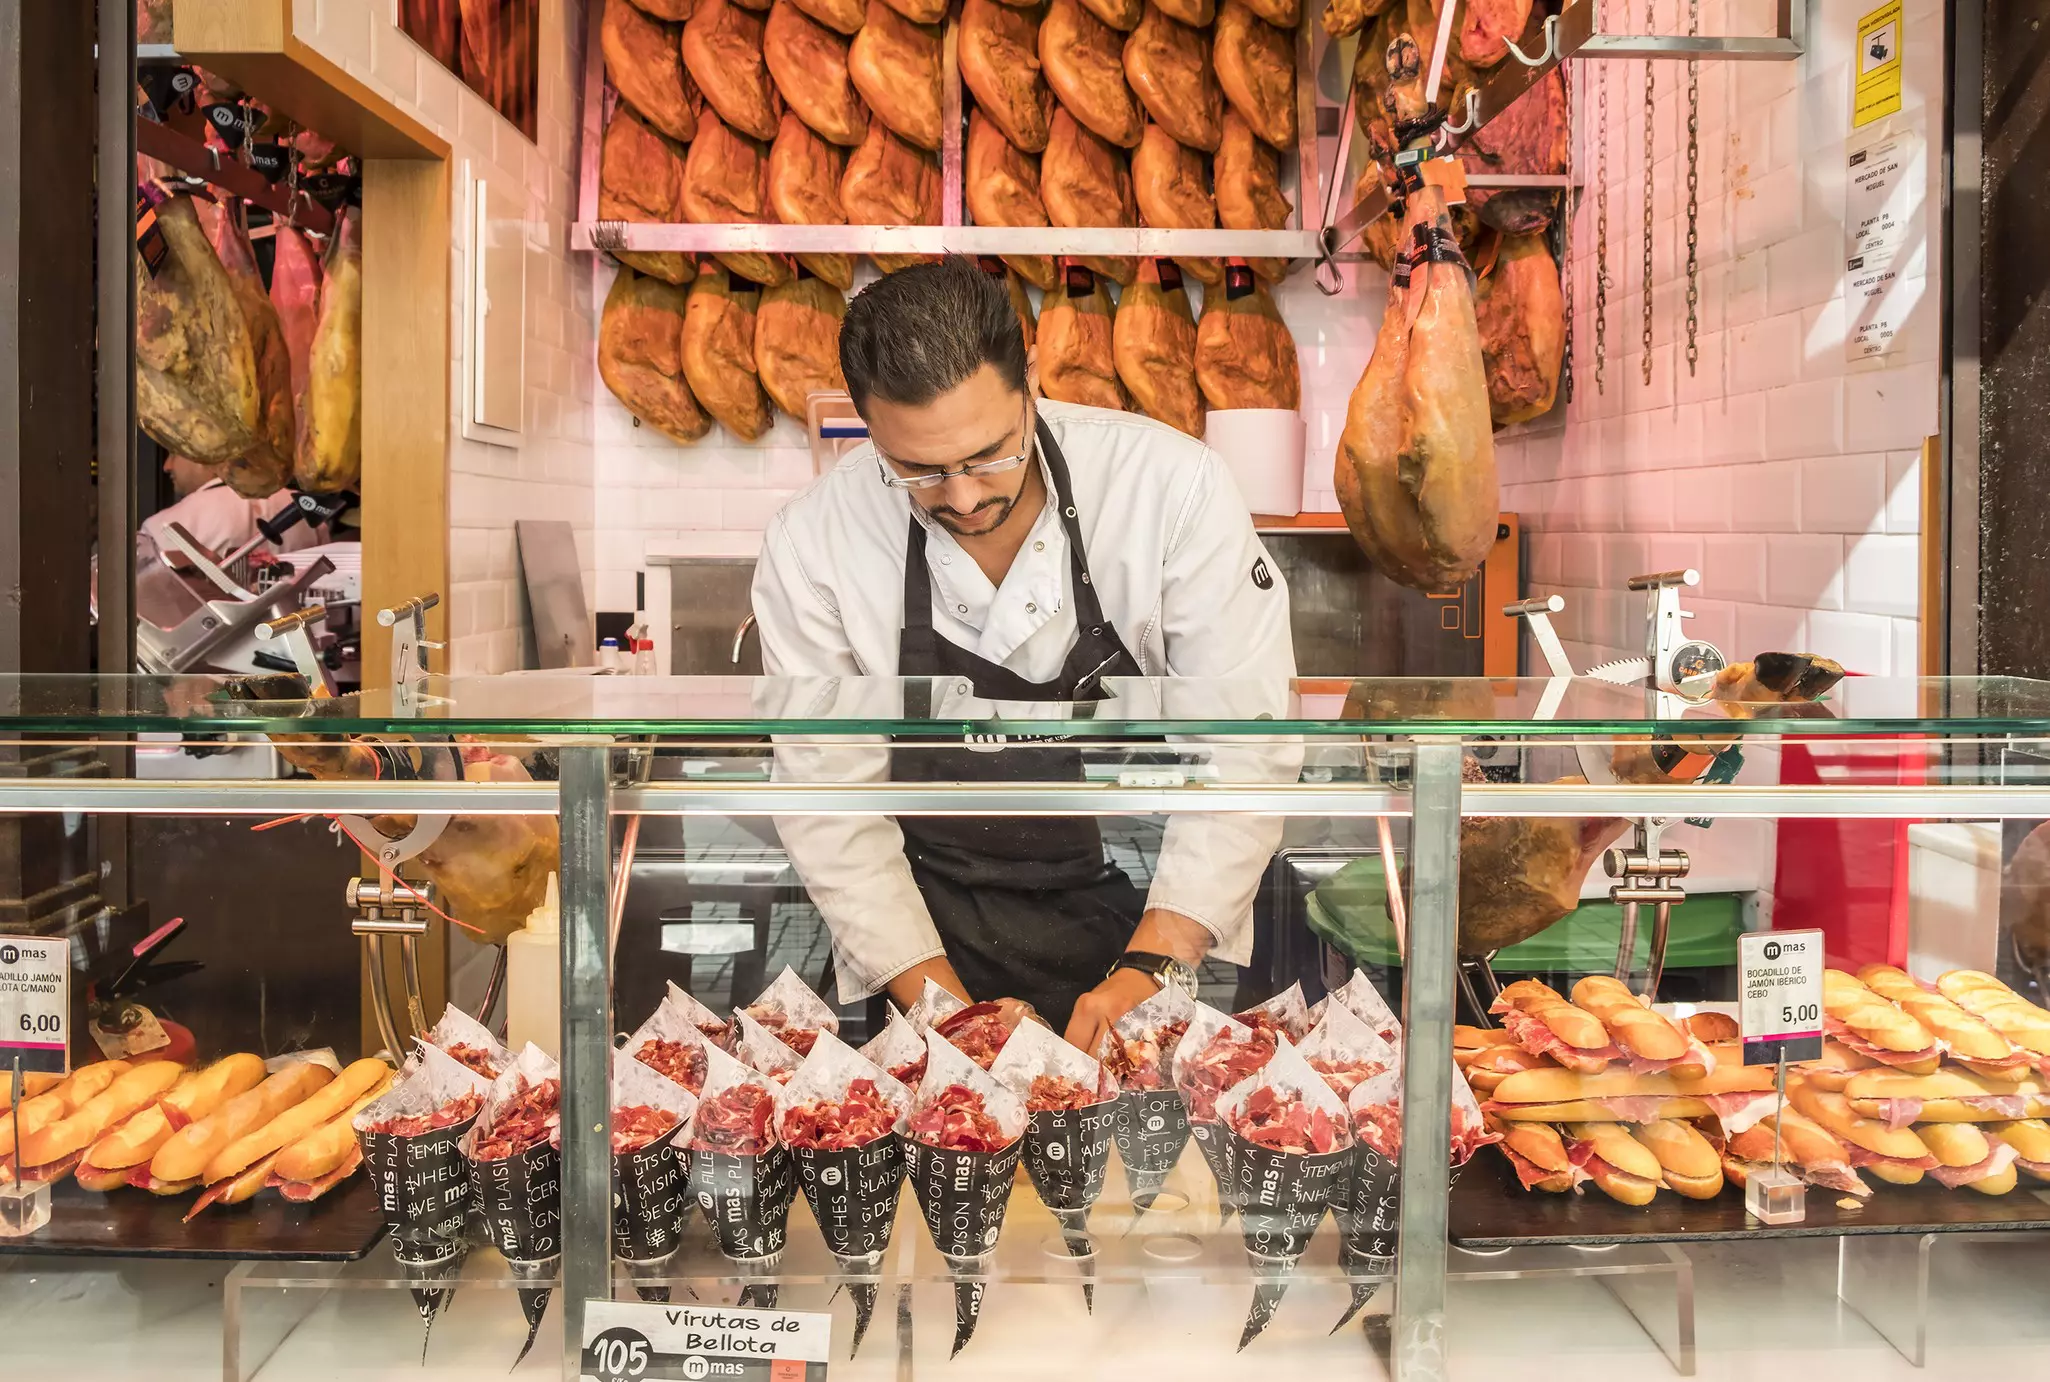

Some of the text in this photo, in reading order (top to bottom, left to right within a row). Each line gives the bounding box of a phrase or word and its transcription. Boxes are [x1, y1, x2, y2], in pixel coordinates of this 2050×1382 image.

[1855, 170, 1878, 184] MERCADO
[1879, 167, 1886, 175] DE
[1887, 162, 1898, 172] SAN
[1856, 221, 1895, 239] LOCAL 0004
[1861, 216, 1880, 228] PLANTA
[1865, 240, 1883, 250] CENTRO
[1853, 277, 1875, 288] MERCADO
[1884, 272, 1895, 280] SAN
[1860, 323, 1878, 332] PLANTA
[1854, 331, 1893, 343] LOCAL 0005
[1864, 345, 1881, 354] CENTRO
[21, 949, 47, 959] mas
[1783, 942, 1806, 952] mas
[31, 972, 62, 983] JAMÓN
[1747, 966, 1802, 978] BOCADILLO DE
[20, 984, 56, 993] C/MANO
[1747, 975, 1807, 989] JAMÓN IBÉRICO
[1747, 989, 1768, 999] CEBO
[1782, 1004, 1818, 1026] 5,00
[20, 1014, 60, 1034] 6,00
[954, 1155, 972, 1192] mas
[384, 1170, 396, 1211] mas
[444, 1182, 472, 1204] ma
[1259, 1169, 1279, 1206] mas
[725, 1187, 743, 1223] mas
[498, 1218, 519, 1251] mas
[665, 1309, 800, 1333] Virutas de
[686, 1333, 777, 1354] Bellota
[594, 1338, 648, 1376] 105
[710, 1361, 745, 1375] mas
